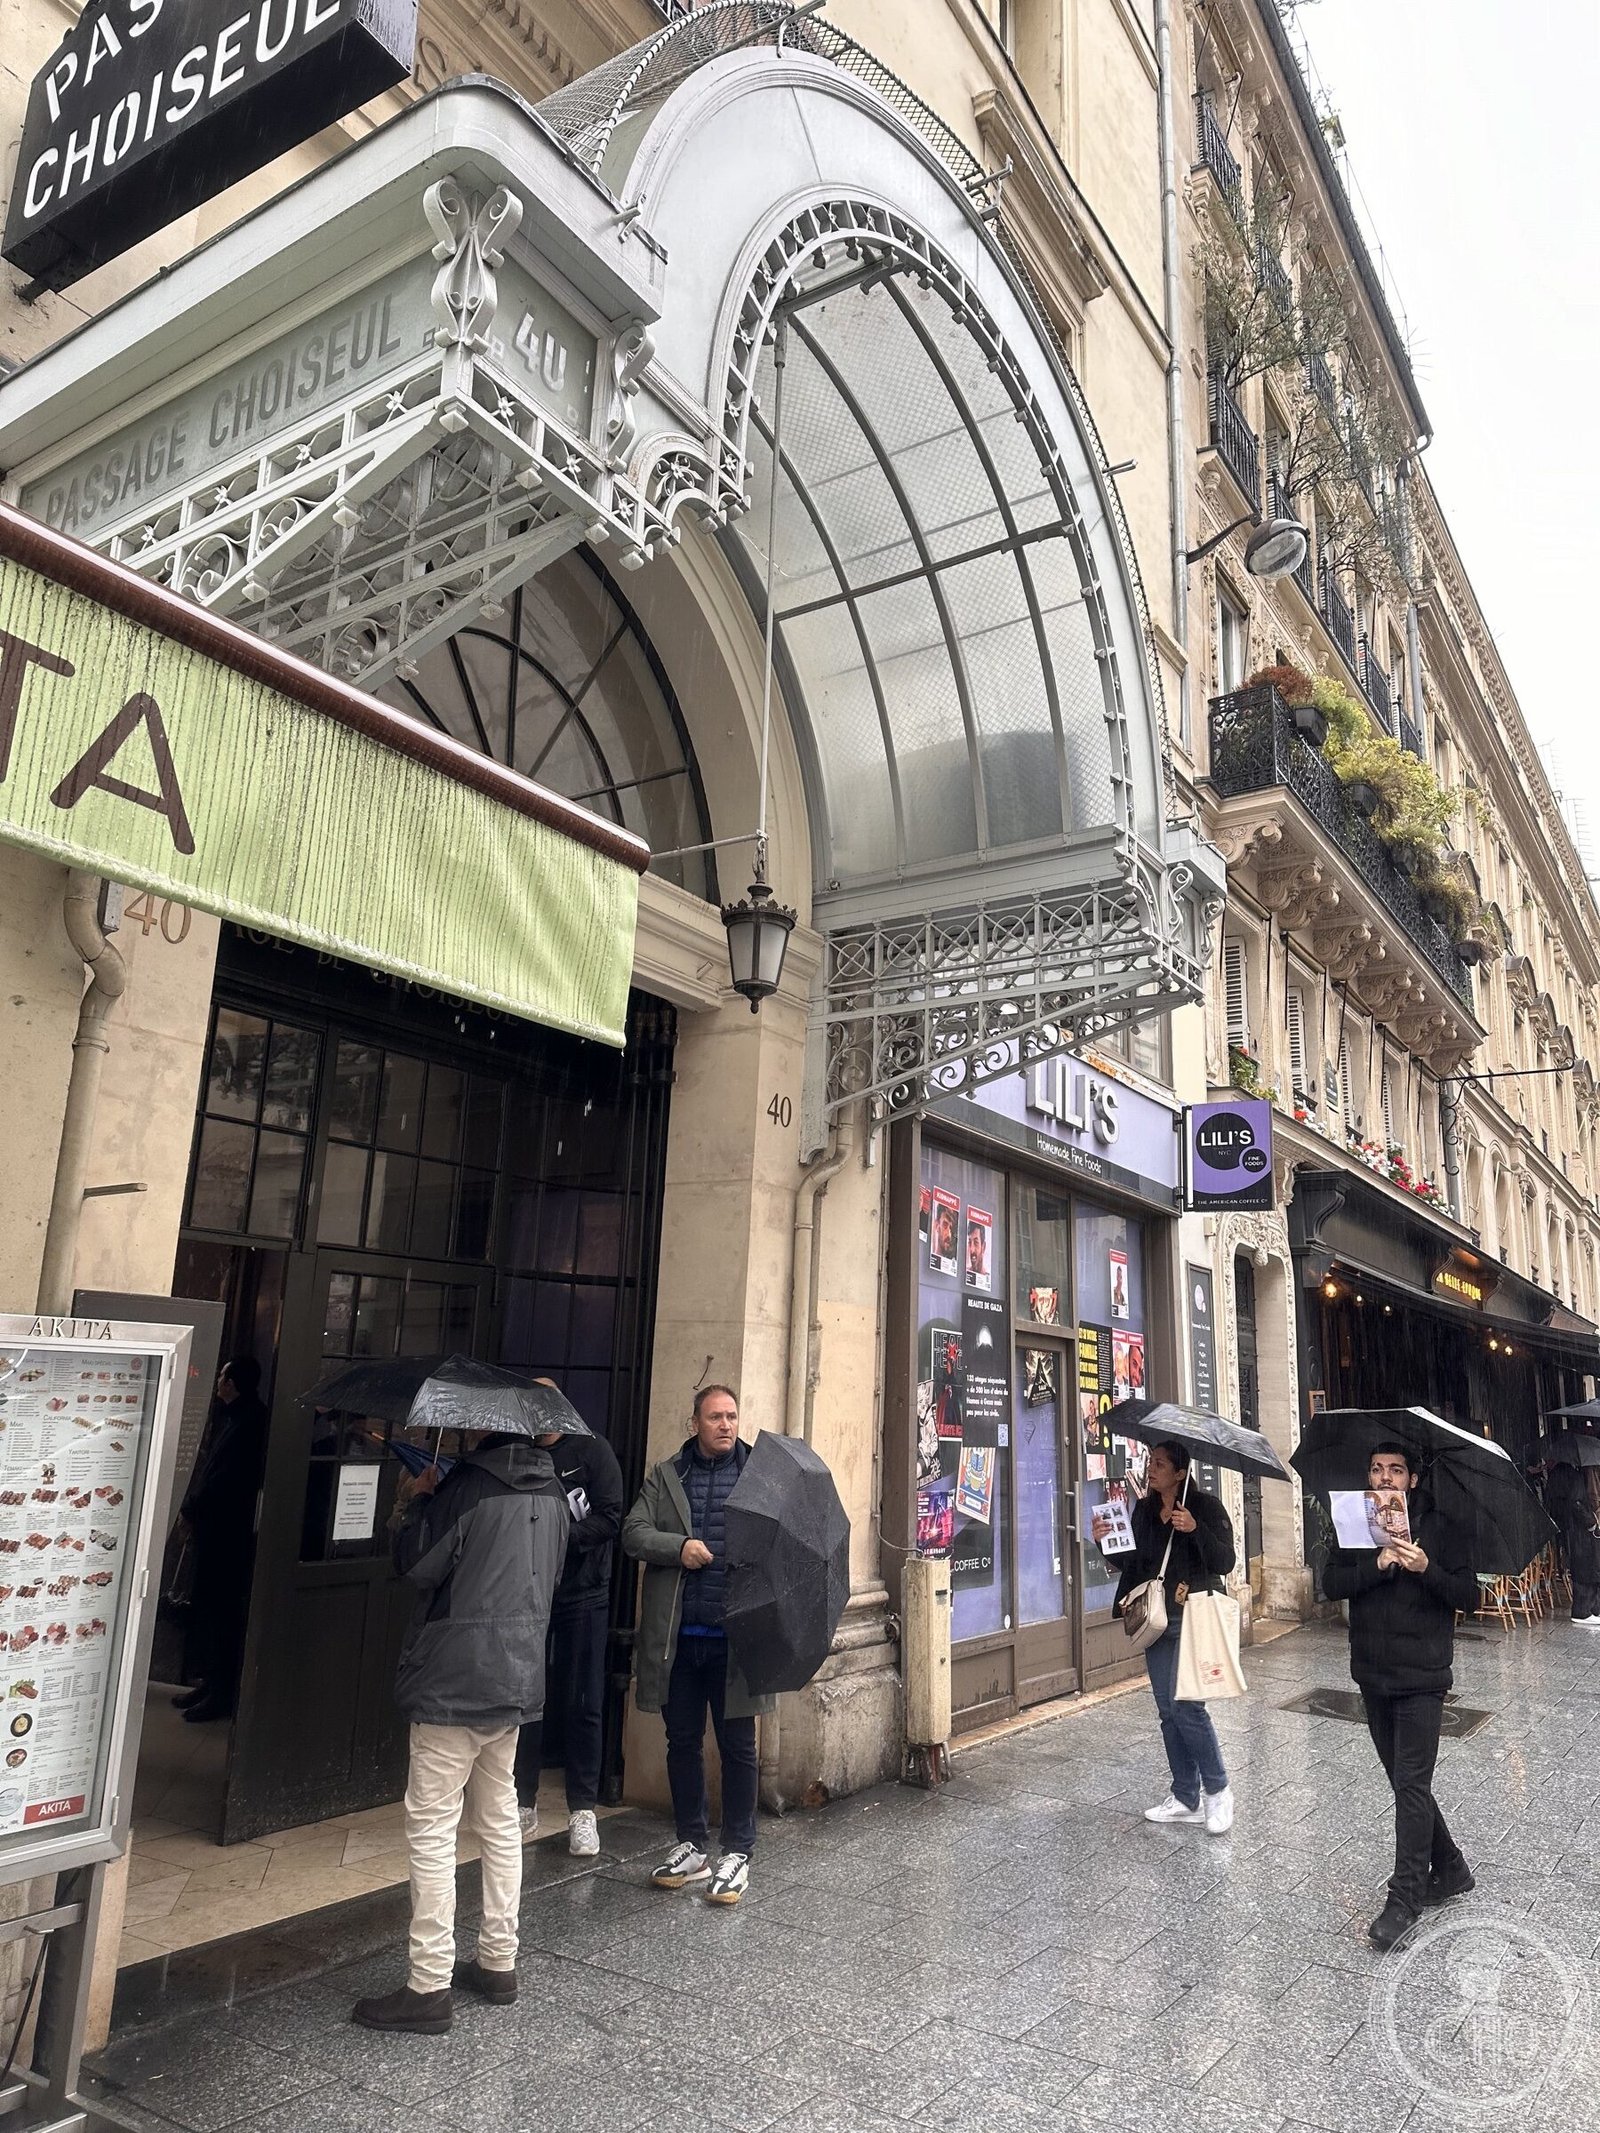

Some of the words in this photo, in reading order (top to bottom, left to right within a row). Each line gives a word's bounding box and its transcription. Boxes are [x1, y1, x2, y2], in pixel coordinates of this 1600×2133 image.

[24, 0, 341, 219] CHOISEUL
[46, 410, 193, 534] PASSAGE
[208, 292, 402, 450] CHOISEUL
[124, 889, 191, 944] 40
[767, 1093, 792, 1128] 40
[1200, 1129, 1252, 1147] LILI'S
[1036, 1132, 1070, 1161] Homemade
[1071, 1147, 1084, 1168] Fine
[1084, 1153, 1102, 1174] Foods
[990, 1303, 1003, 1313] GAZA
[28, 1316, 114, 1340] AKITA
[953, 1556, 980, 1572] COFFEE
[38, 1799, 72, 1817] AKITA
